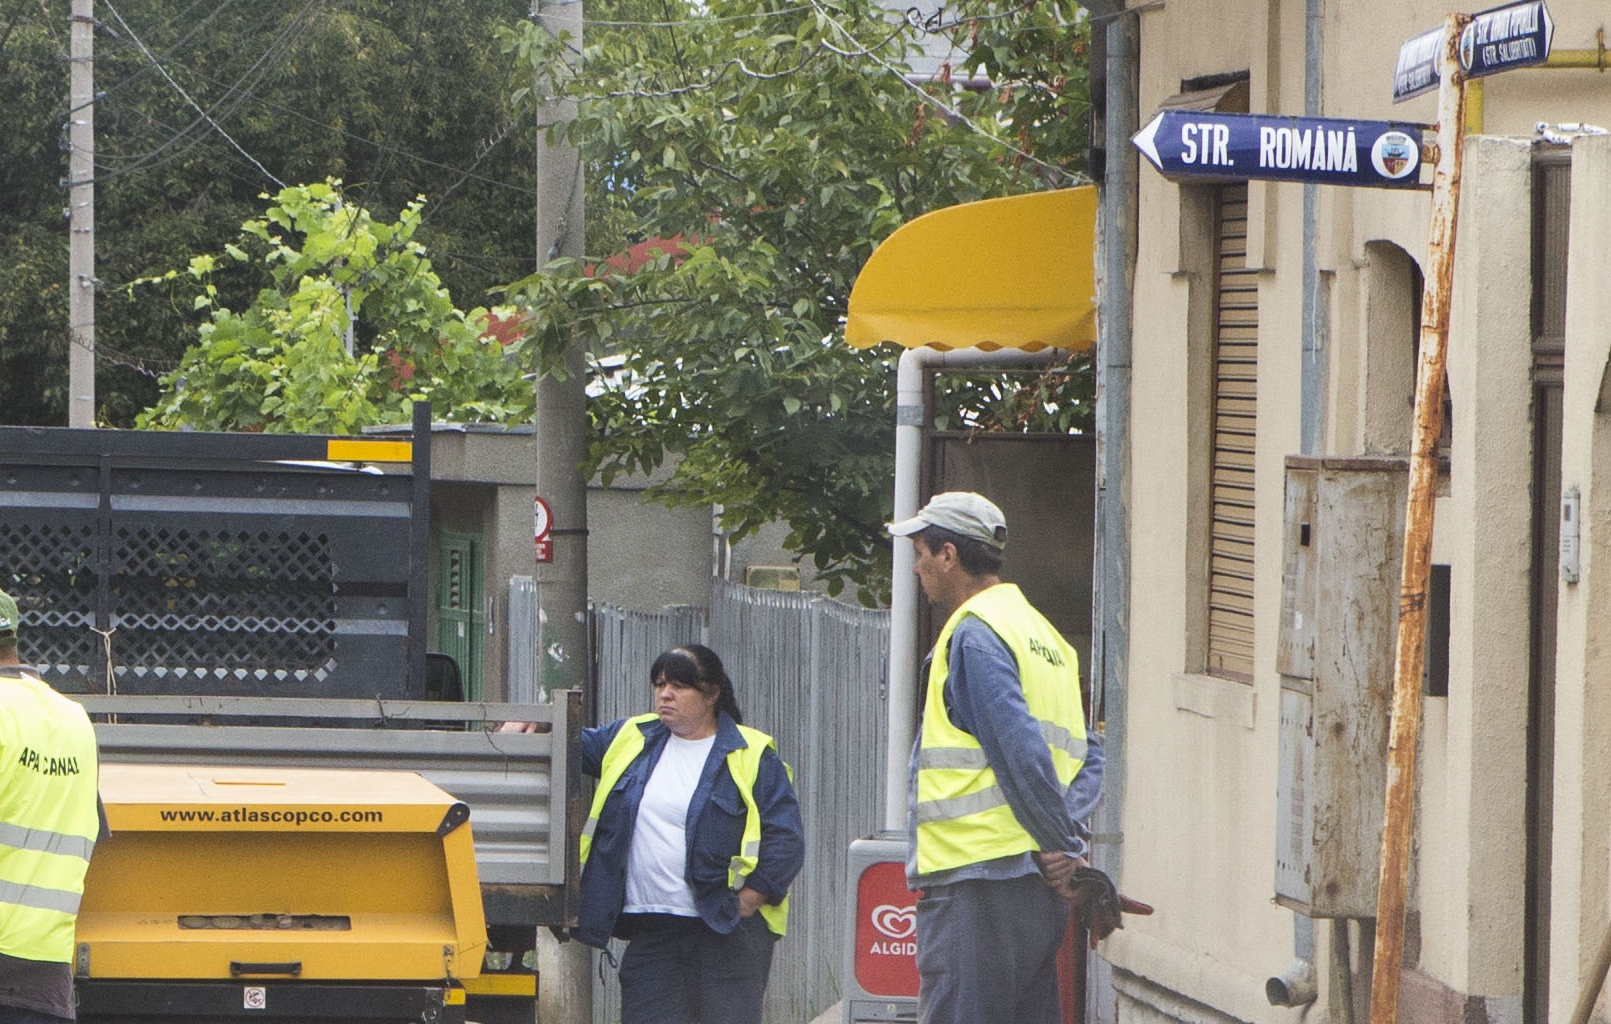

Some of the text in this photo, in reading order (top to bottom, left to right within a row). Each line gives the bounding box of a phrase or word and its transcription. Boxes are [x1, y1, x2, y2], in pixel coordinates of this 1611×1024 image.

[1181, 122, 1234, 166] STR.
[18, 746, 40, 772] APA
[160, 807, 384, 826] www.atlascopco.com
[869, 941, 917, 956] ALGID
